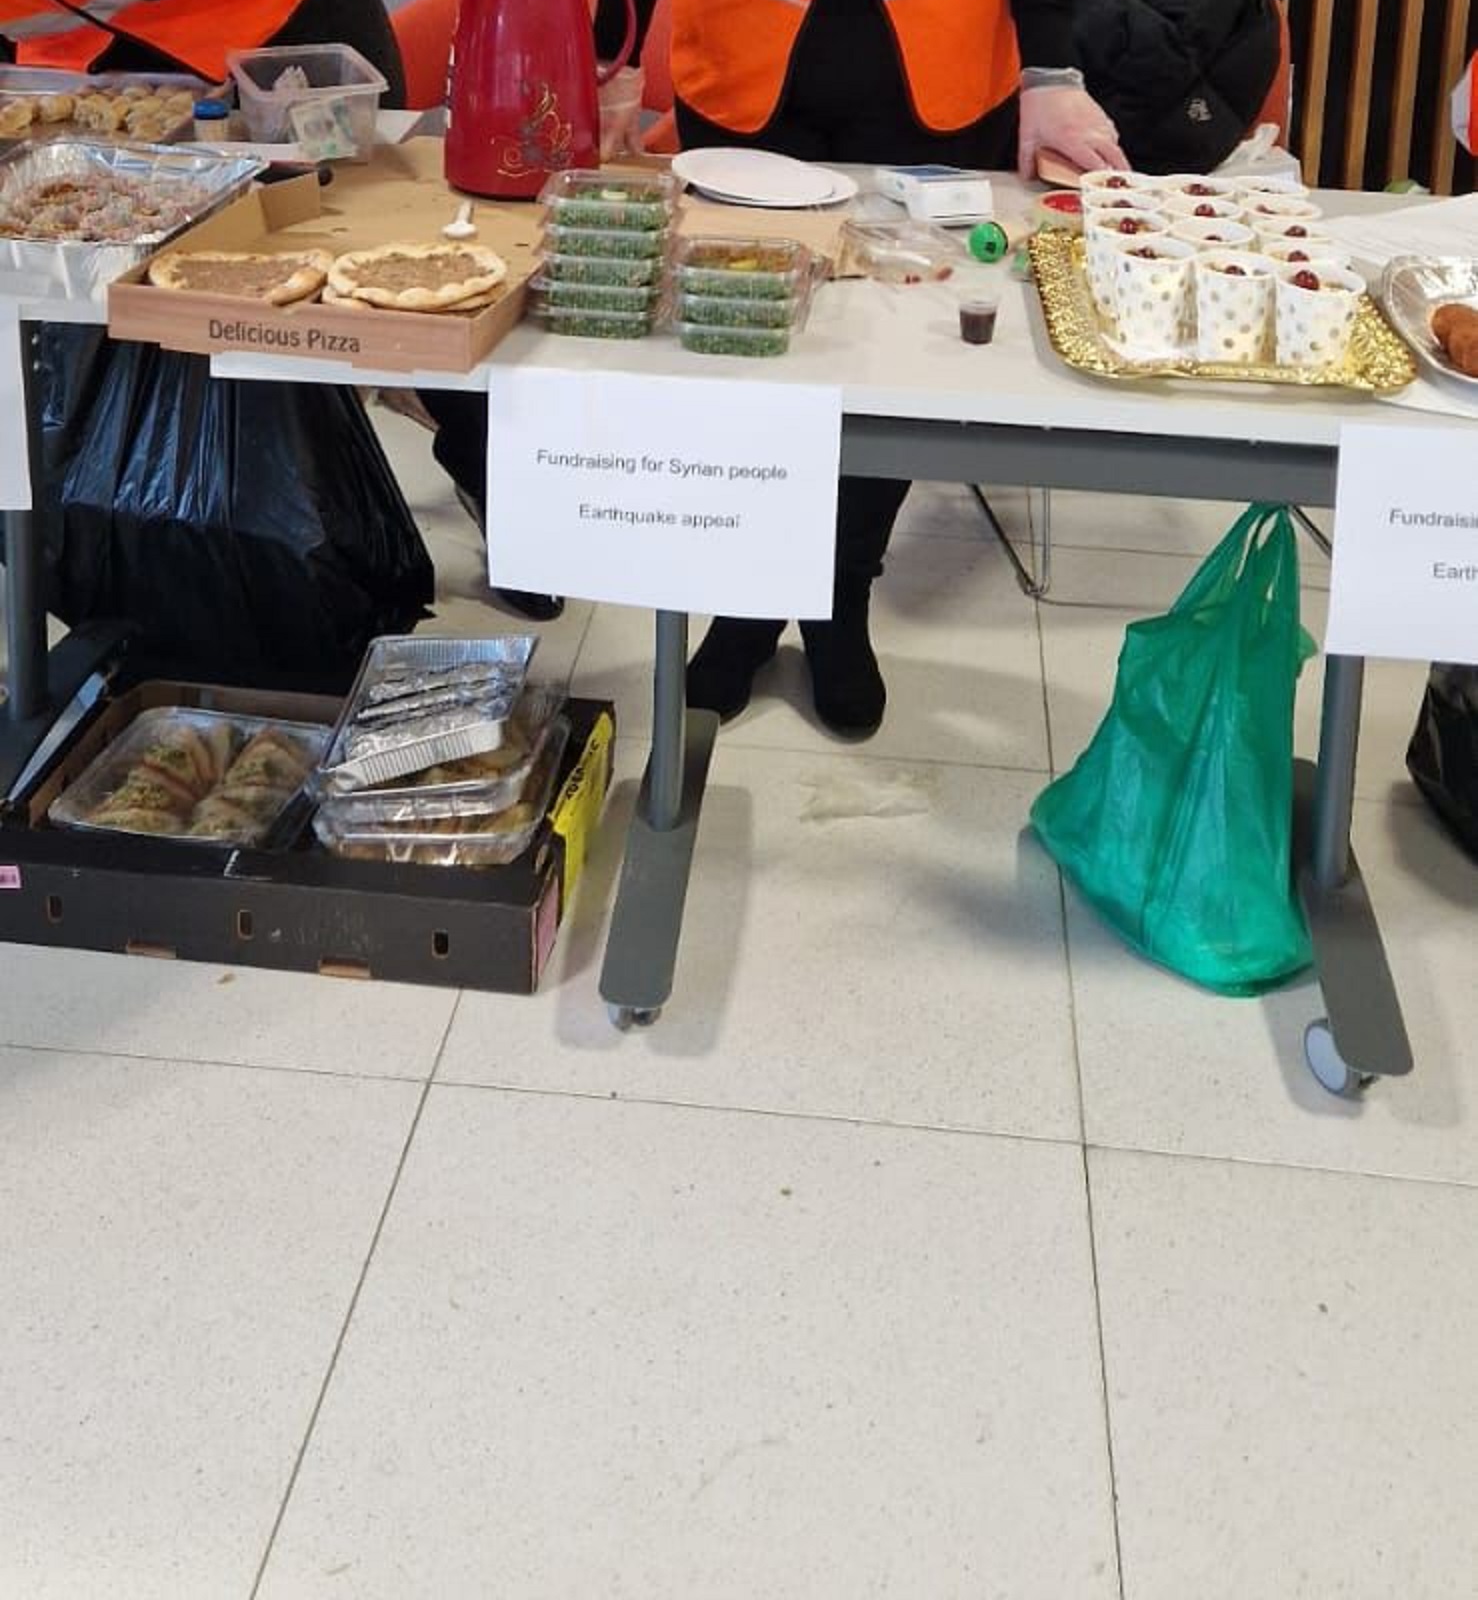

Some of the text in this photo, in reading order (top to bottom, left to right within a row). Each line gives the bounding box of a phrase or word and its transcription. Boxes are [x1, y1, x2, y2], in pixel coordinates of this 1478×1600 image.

[209, 319, 361, 353] Delicious Pizza
[536, 449, 788, 481] Fundraising for Syrian people
[579, 504, 741, 529] Earthquake appeal
